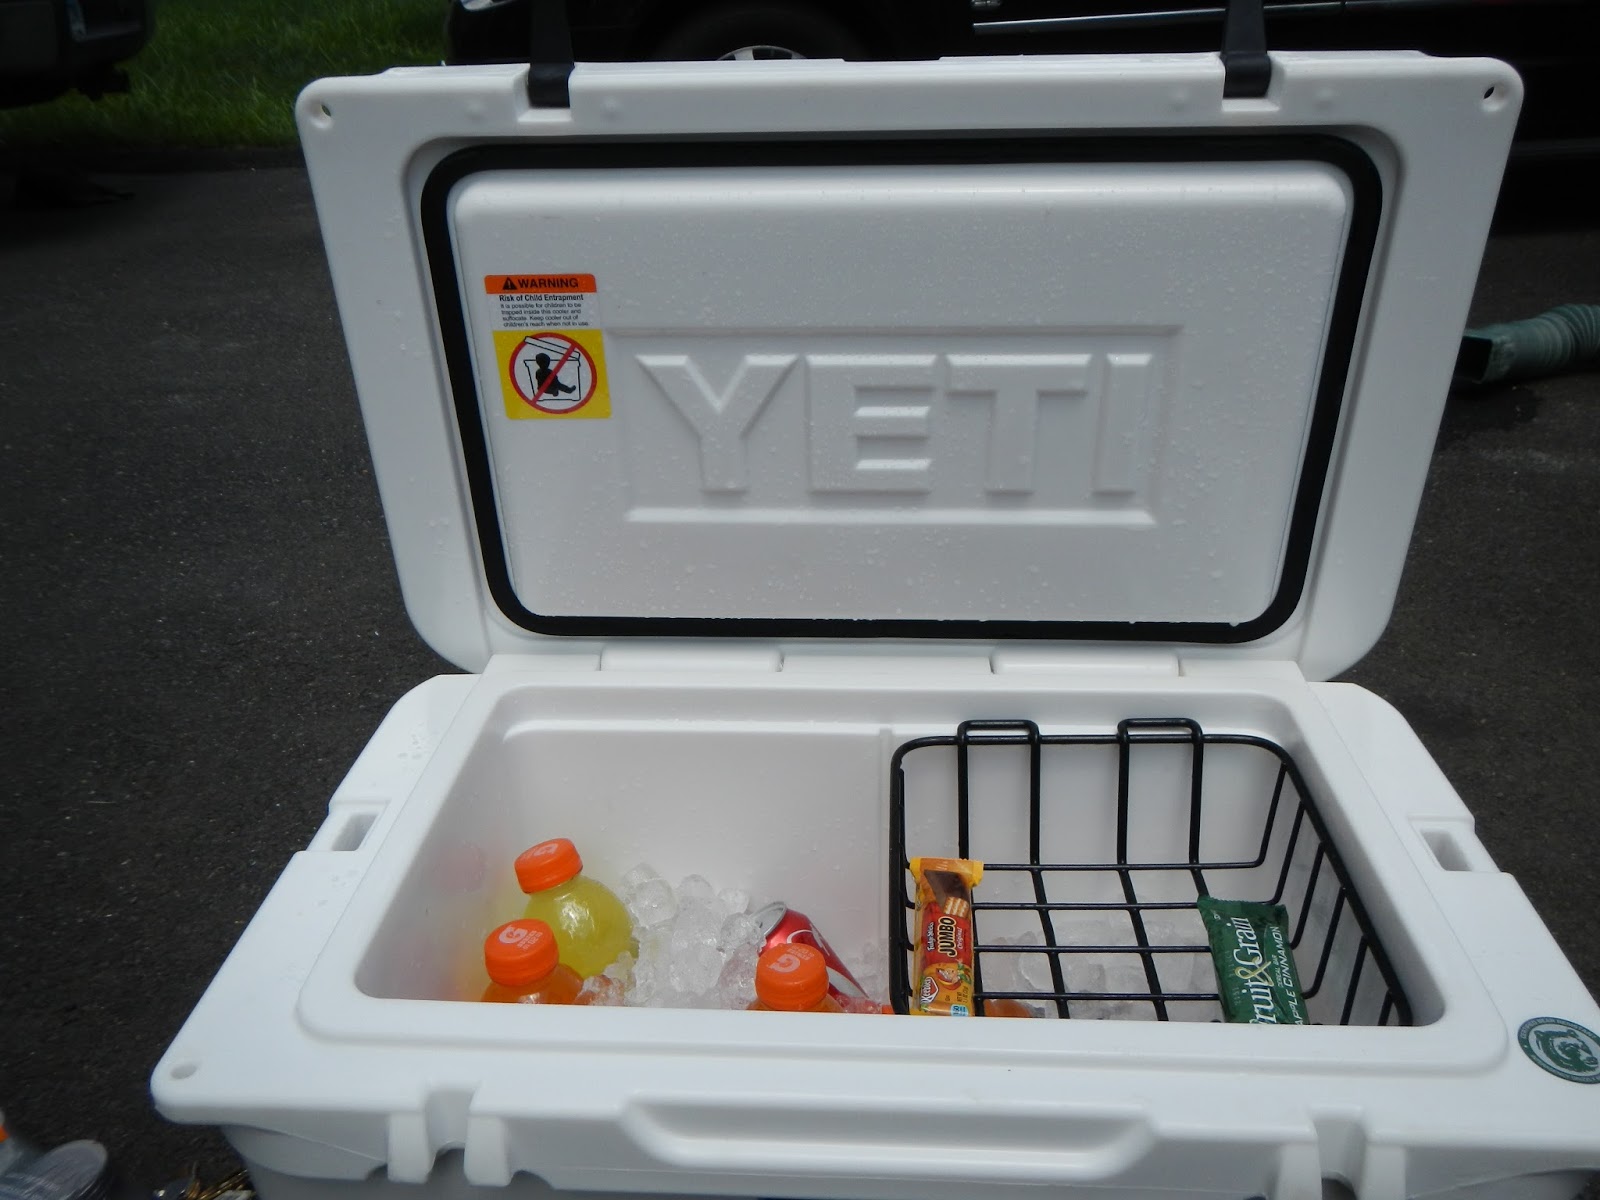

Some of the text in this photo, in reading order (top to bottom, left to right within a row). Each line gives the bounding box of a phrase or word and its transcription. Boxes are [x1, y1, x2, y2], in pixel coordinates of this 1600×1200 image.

[518, 278, 579, 288] WARNING
[499, 294, 514, 302] Risk
[544, 294, 584, 302] Entrapment
[635, 353, 1153, 498] YETI
[498, 924, 528, 944] G
[938, 916, 957, 957] JUMBO
[956, 927, 964, 950] Original
[768, 953, 801, 973] G
[1270, 926, 1304, 1025] APPLE CINNAMON
